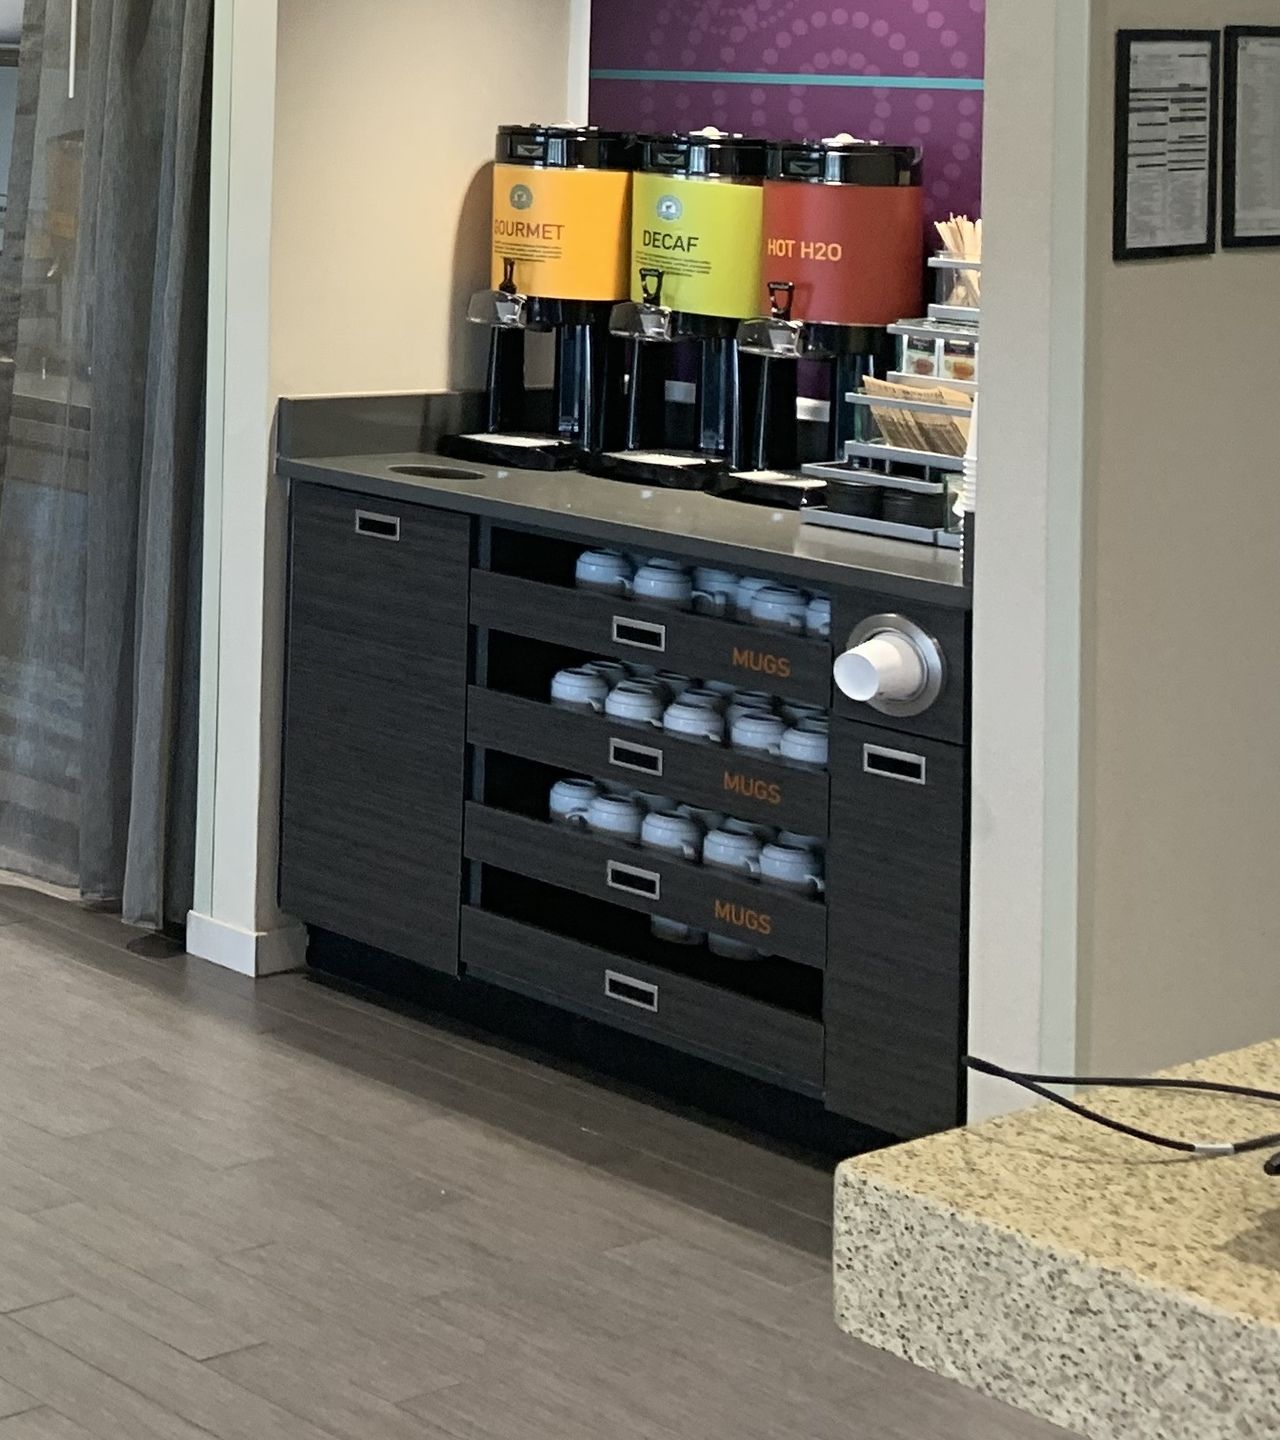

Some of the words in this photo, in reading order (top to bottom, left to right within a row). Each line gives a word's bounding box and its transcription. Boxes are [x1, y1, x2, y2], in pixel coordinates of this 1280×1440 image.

[643, 229, 699, 253] DECAF
[767, 238, 796, 258] HOT
[732, 647, 791, 678] MUGS
[723, 771, 781, 805] MUGS
[714, 899, 772, 935] MUGS
